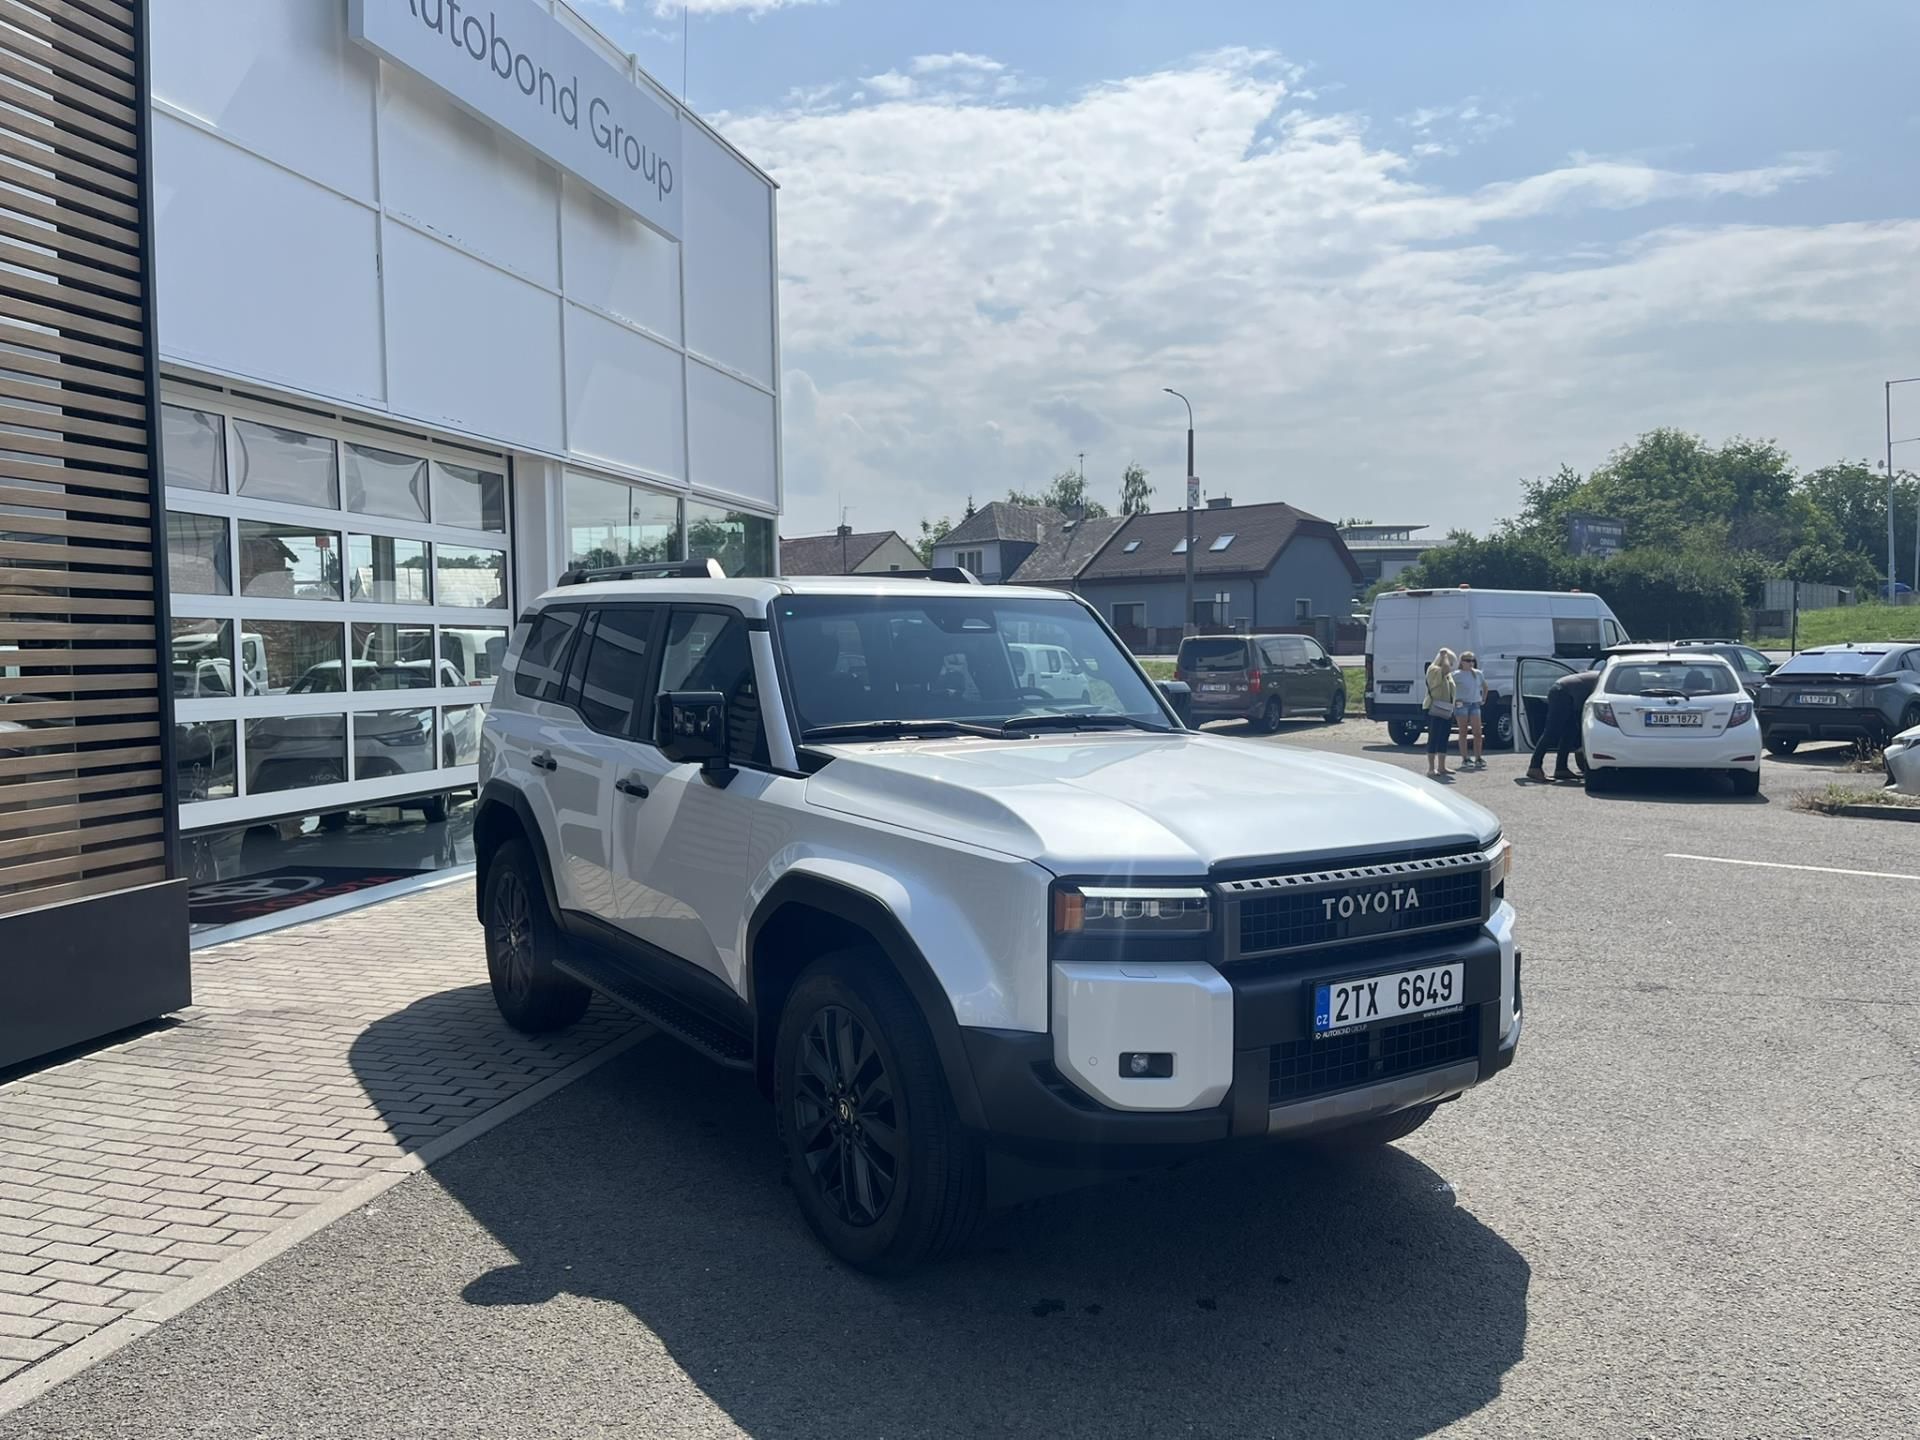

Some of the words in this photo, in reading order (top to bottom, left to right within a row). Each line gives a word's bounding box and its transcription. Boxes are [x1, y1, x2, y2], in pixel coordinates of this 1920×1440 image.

[408, 0, 579, 130] utobond
[589, 97, 673, 202] Group
[1677, 715, 1698, 724] 1872
[1322, 887, 1419, 920] TOYOTA
[1335, 981, 1379, 1022] 2TX
[1398, 969, 1453, 1010] 6649
[1316, 1013, 1329, 1026] CZ
